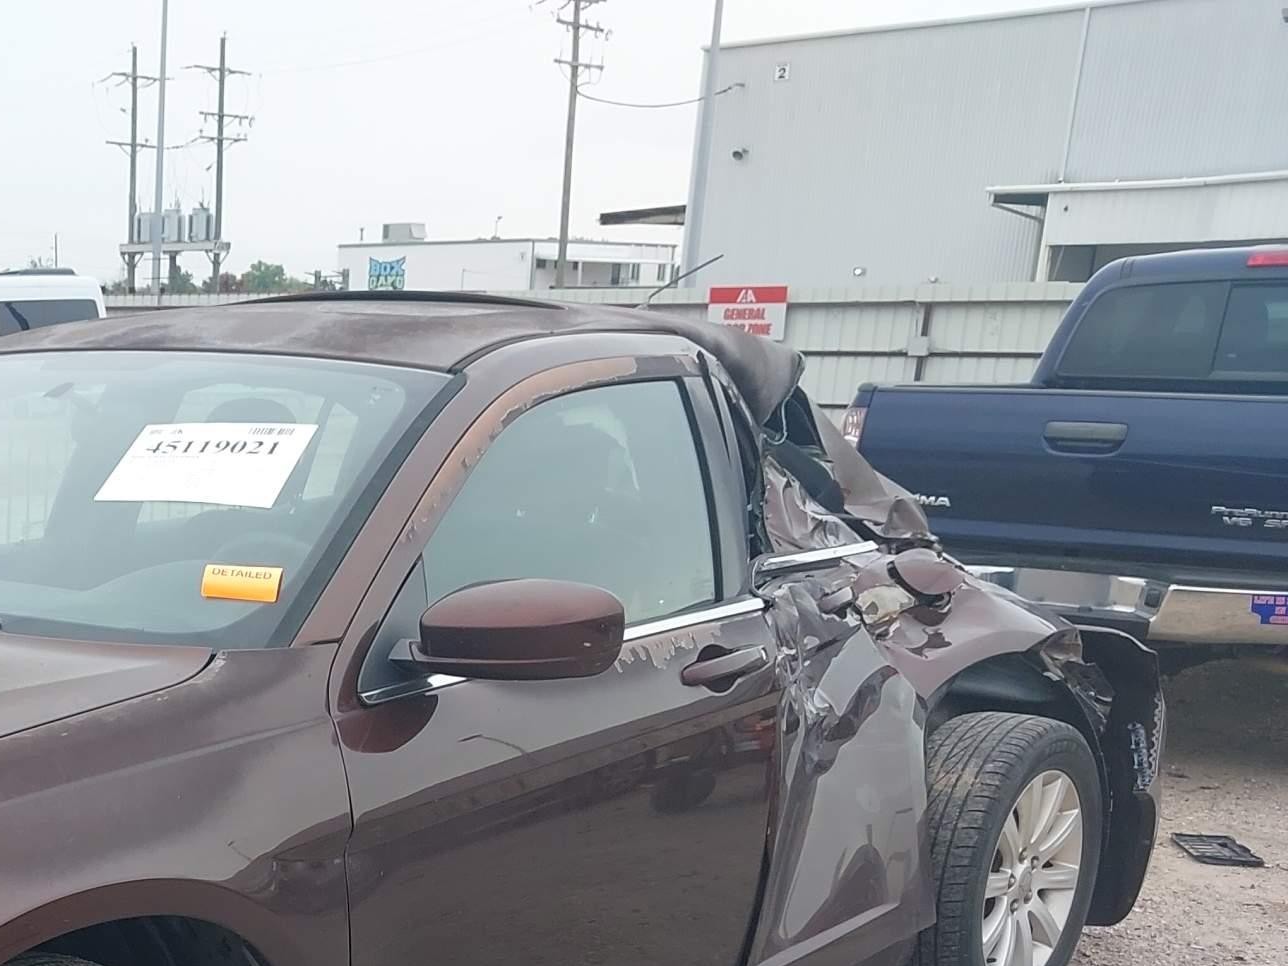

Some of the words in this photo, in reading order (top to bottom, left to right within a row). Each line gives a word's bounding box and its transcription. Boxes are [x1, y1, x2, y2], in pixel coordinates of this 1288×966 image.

[778, 67, 787, 79] 2
[723, 307, 766, 321] GENERAL
[146, 439, 280, 455] 45119021
[211, 567, 272, 580] DETAILED
